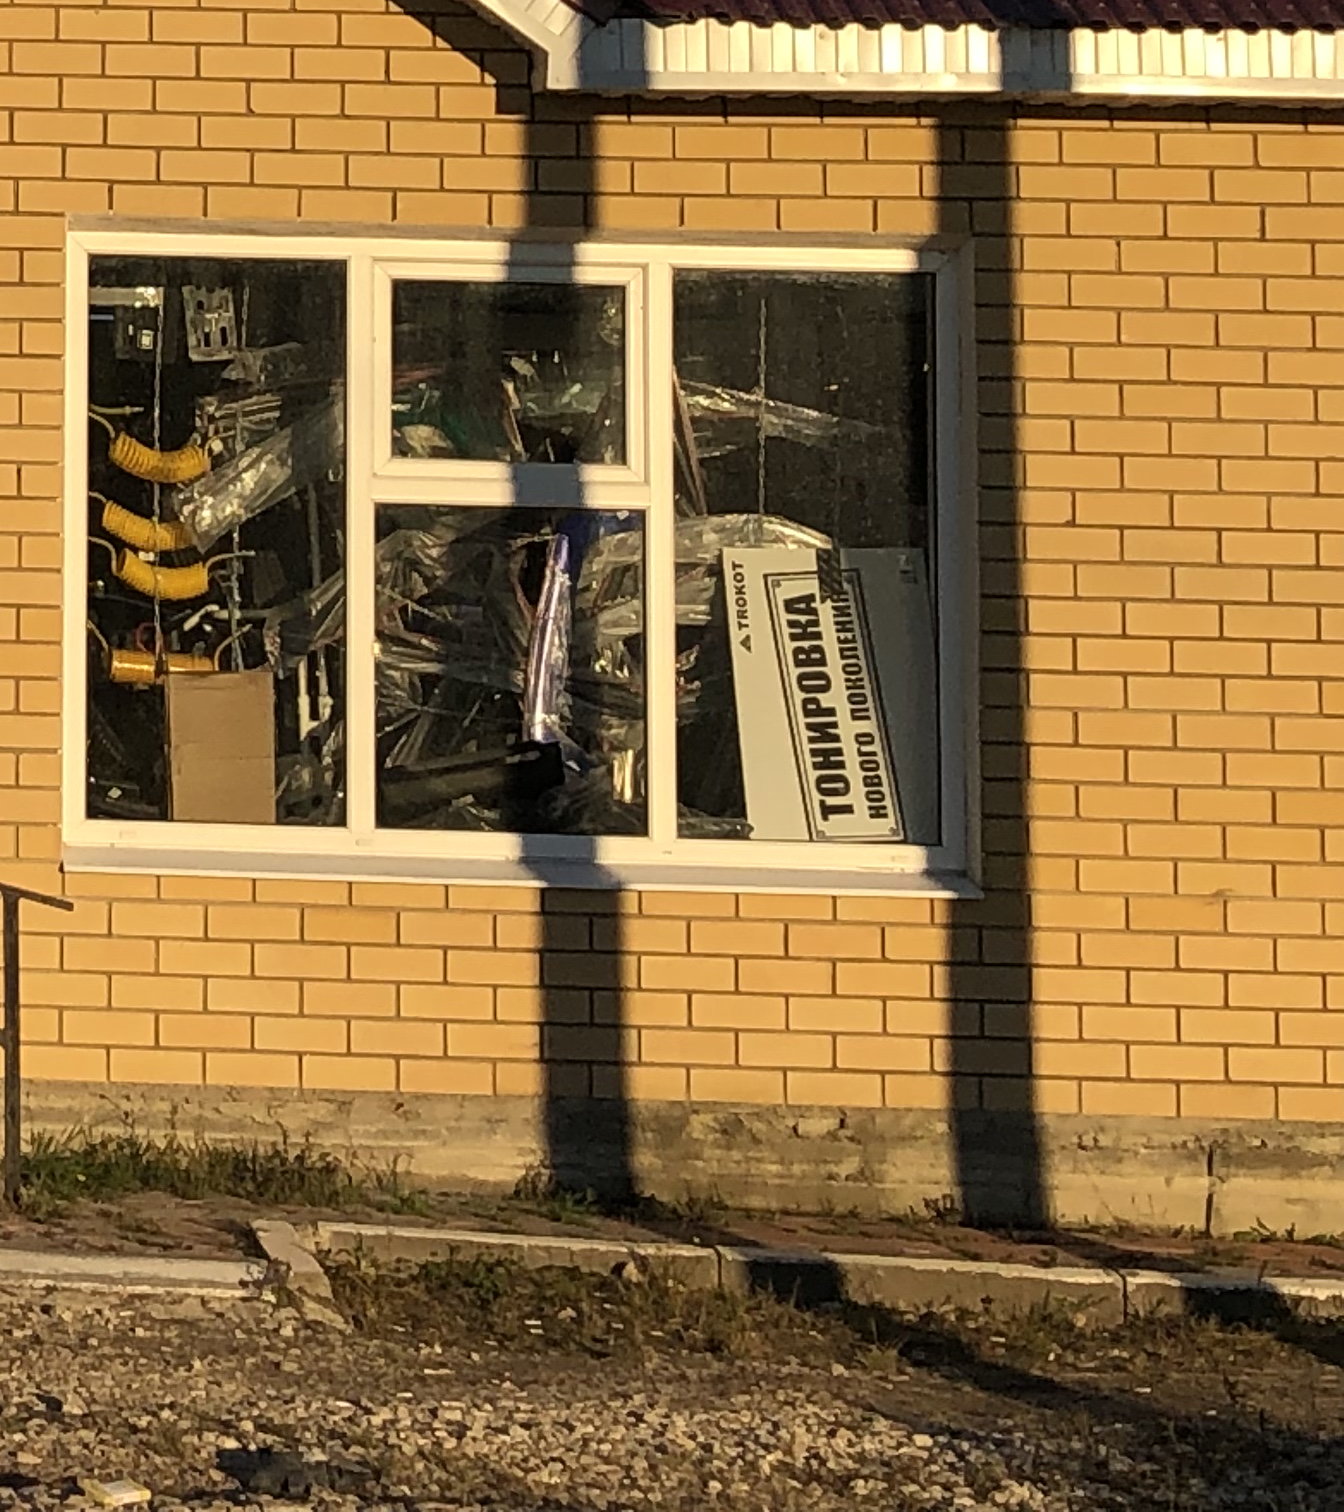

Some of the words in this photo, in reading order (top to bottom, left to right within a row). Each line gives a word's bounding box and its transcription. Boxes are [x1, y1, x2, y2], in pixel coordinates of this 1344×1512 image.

[732, 561, 750, 631] TROKOT
[782, 591, 855, 823] ТОНИРОВКА
[830, 589, 872, 722] ПОКОЛЕНИЯ
[853, 731, 889, 820] НОВОГО
